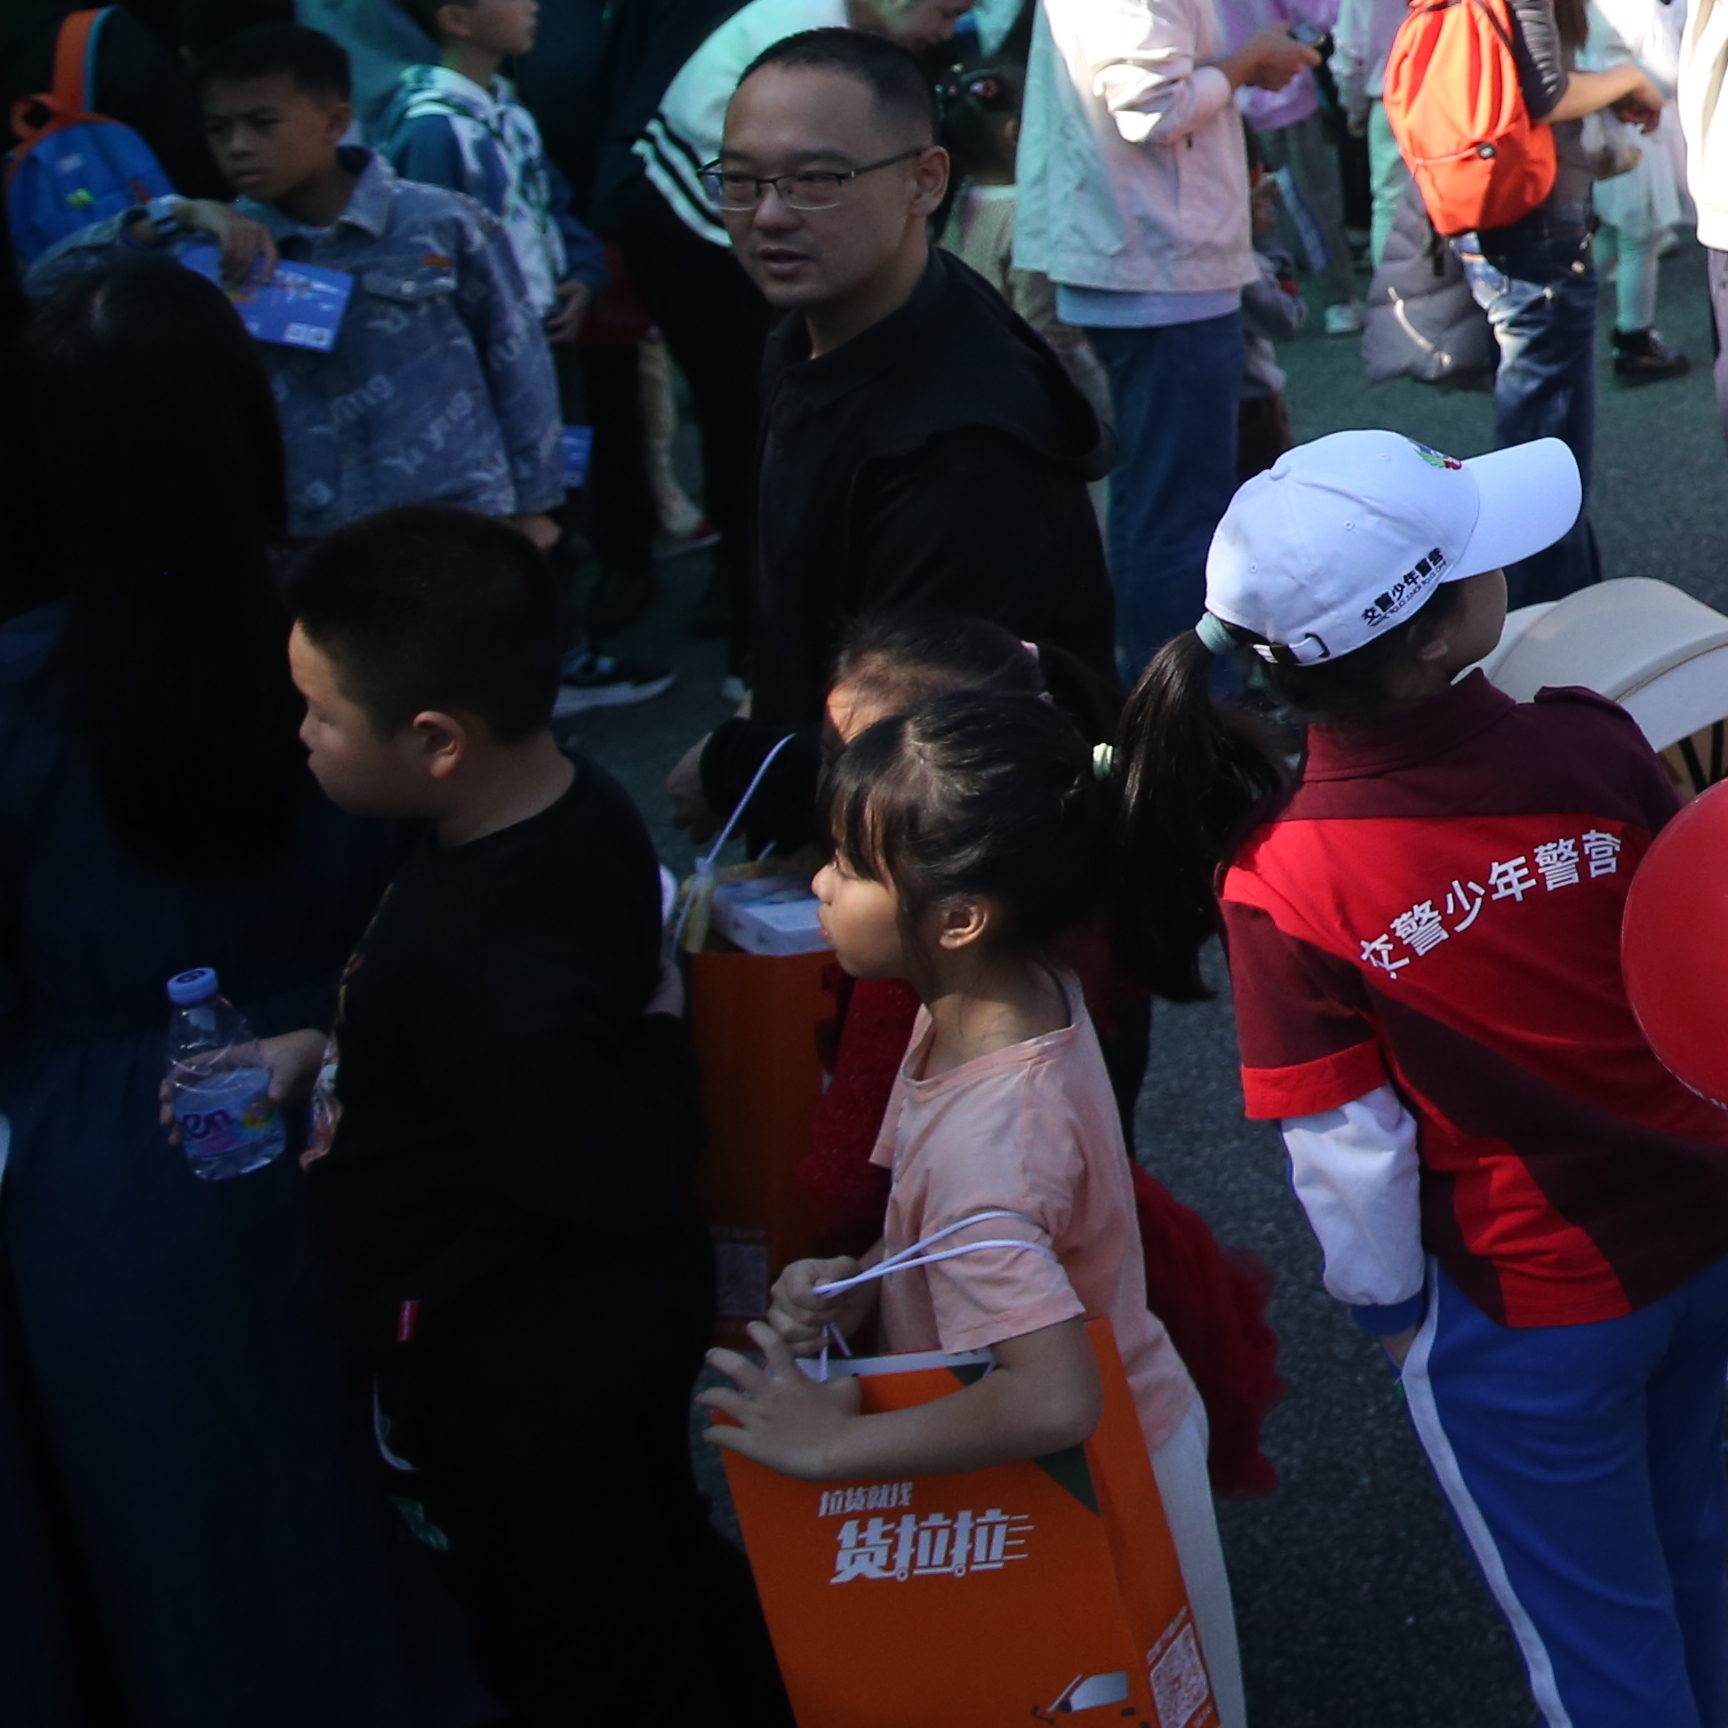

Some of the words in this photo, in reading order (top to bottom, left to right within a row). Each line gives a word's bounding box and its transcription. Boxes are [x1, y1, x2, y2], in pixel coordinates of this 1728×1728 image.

[1361, 547, 1443, 625] 交警少年警营
[1359, 828, 1622, 980] 交警少年警营
[818, 1482, 913, 1518] 拉货就找
[829, 1508, 1012, 1584] 货拉拉
